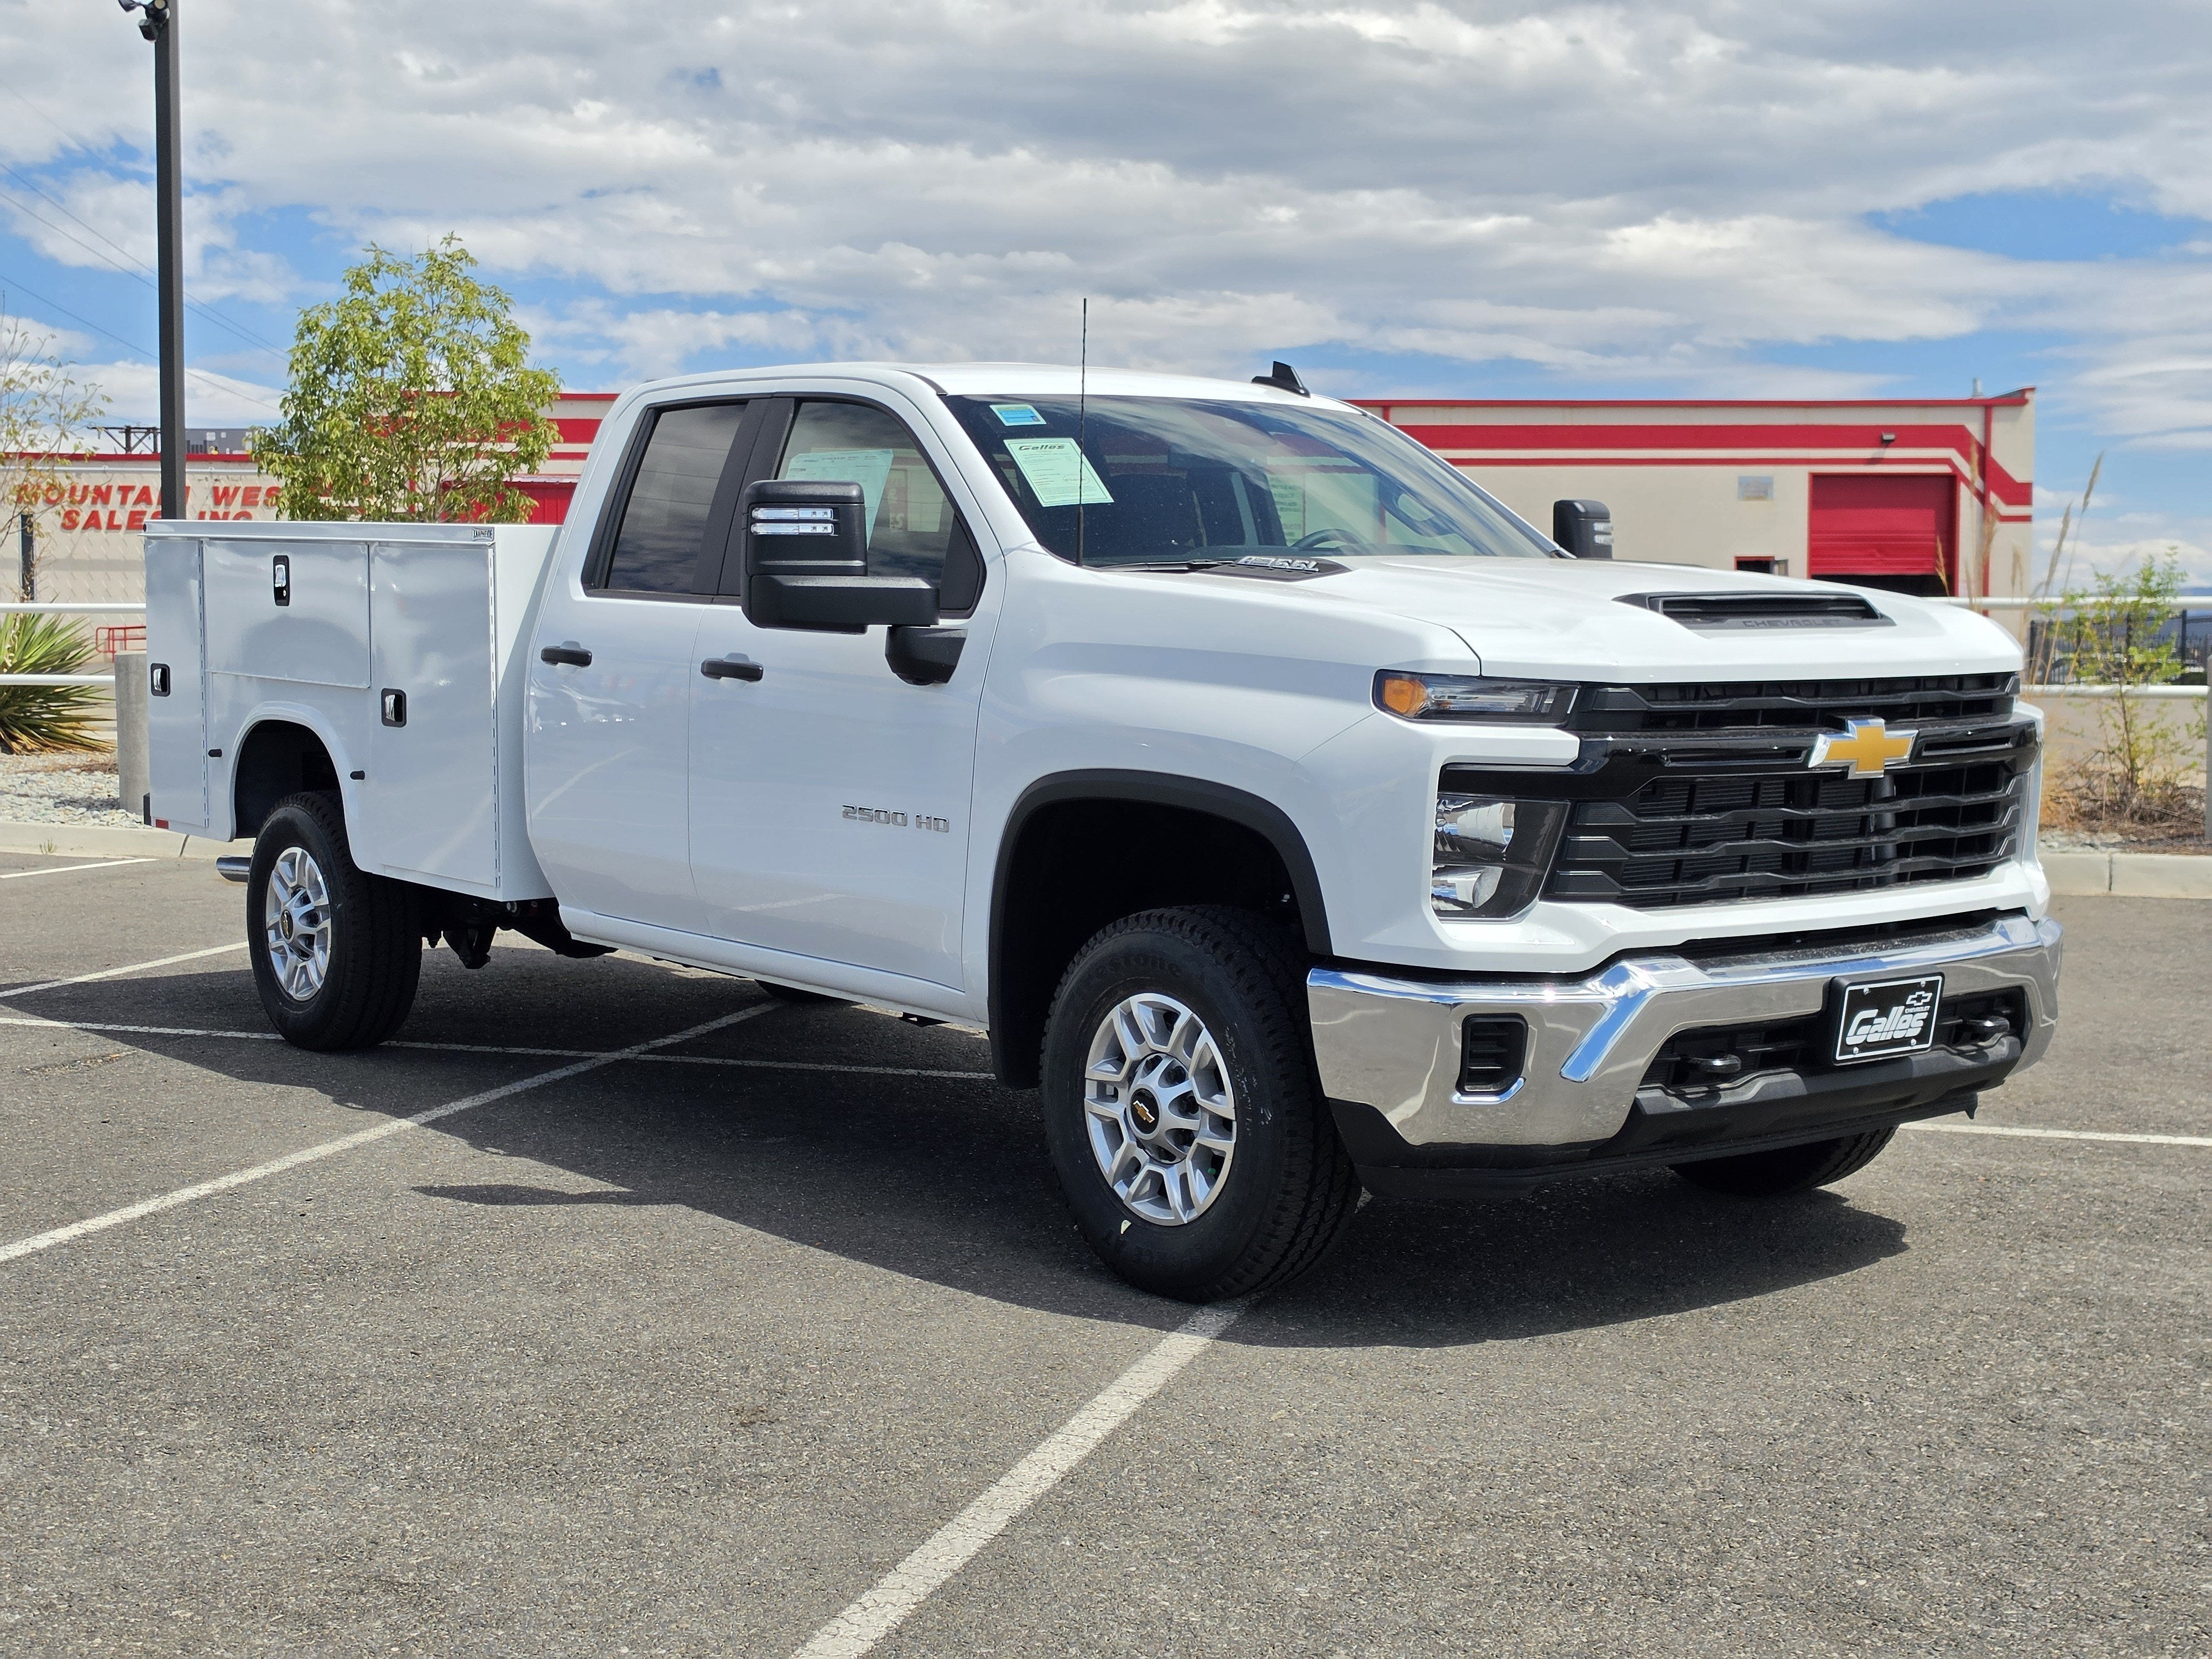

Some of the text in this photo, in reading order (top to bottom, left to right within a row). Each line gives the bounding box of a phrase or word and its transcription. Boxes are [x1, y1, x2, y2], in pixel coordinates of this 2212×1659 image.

[1743, 619, 1841, 628] CHEVROLET
[842, 804, 950, 833] 2500 HD
[1845, 1005, 1929, 1046] Galles
